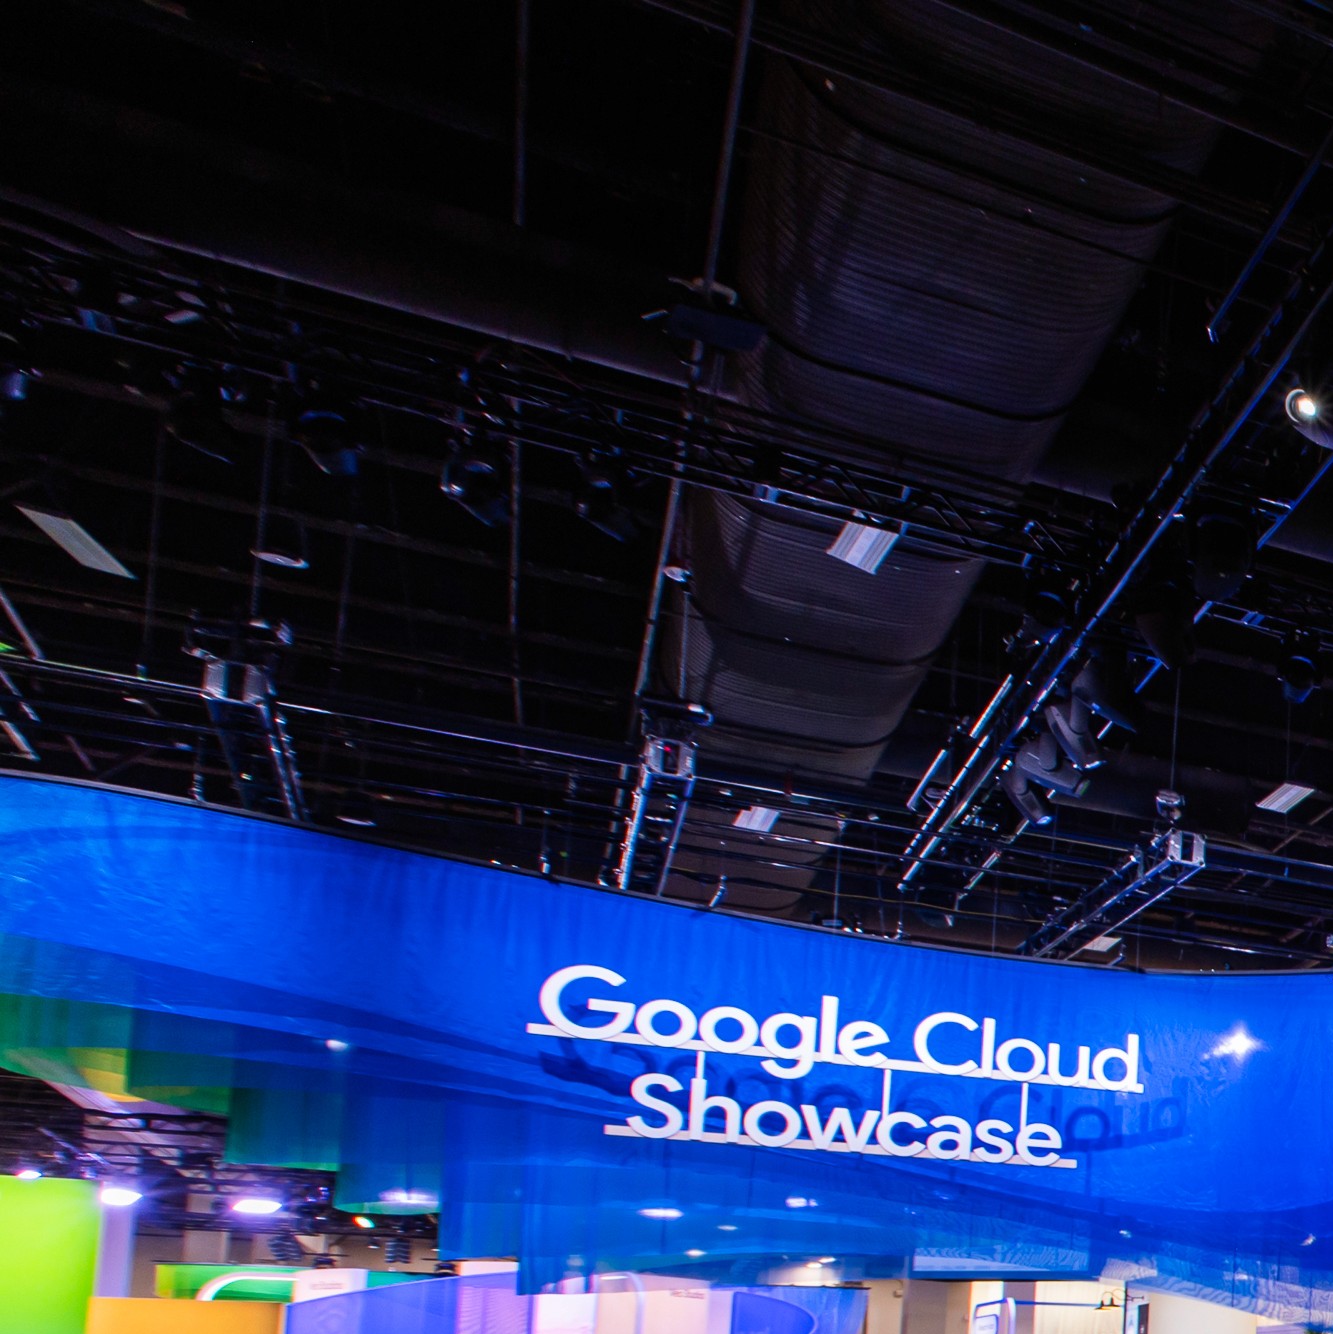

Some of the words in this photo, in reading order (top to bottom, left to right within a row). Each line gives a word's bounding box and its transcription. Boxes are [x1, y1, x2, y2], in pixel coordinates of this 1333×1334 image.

[539, 964, 890, 1079] Google
[913, 1012, 1141, 1091] Cloud
[626, 1072, 1063, 1165] Showcase
